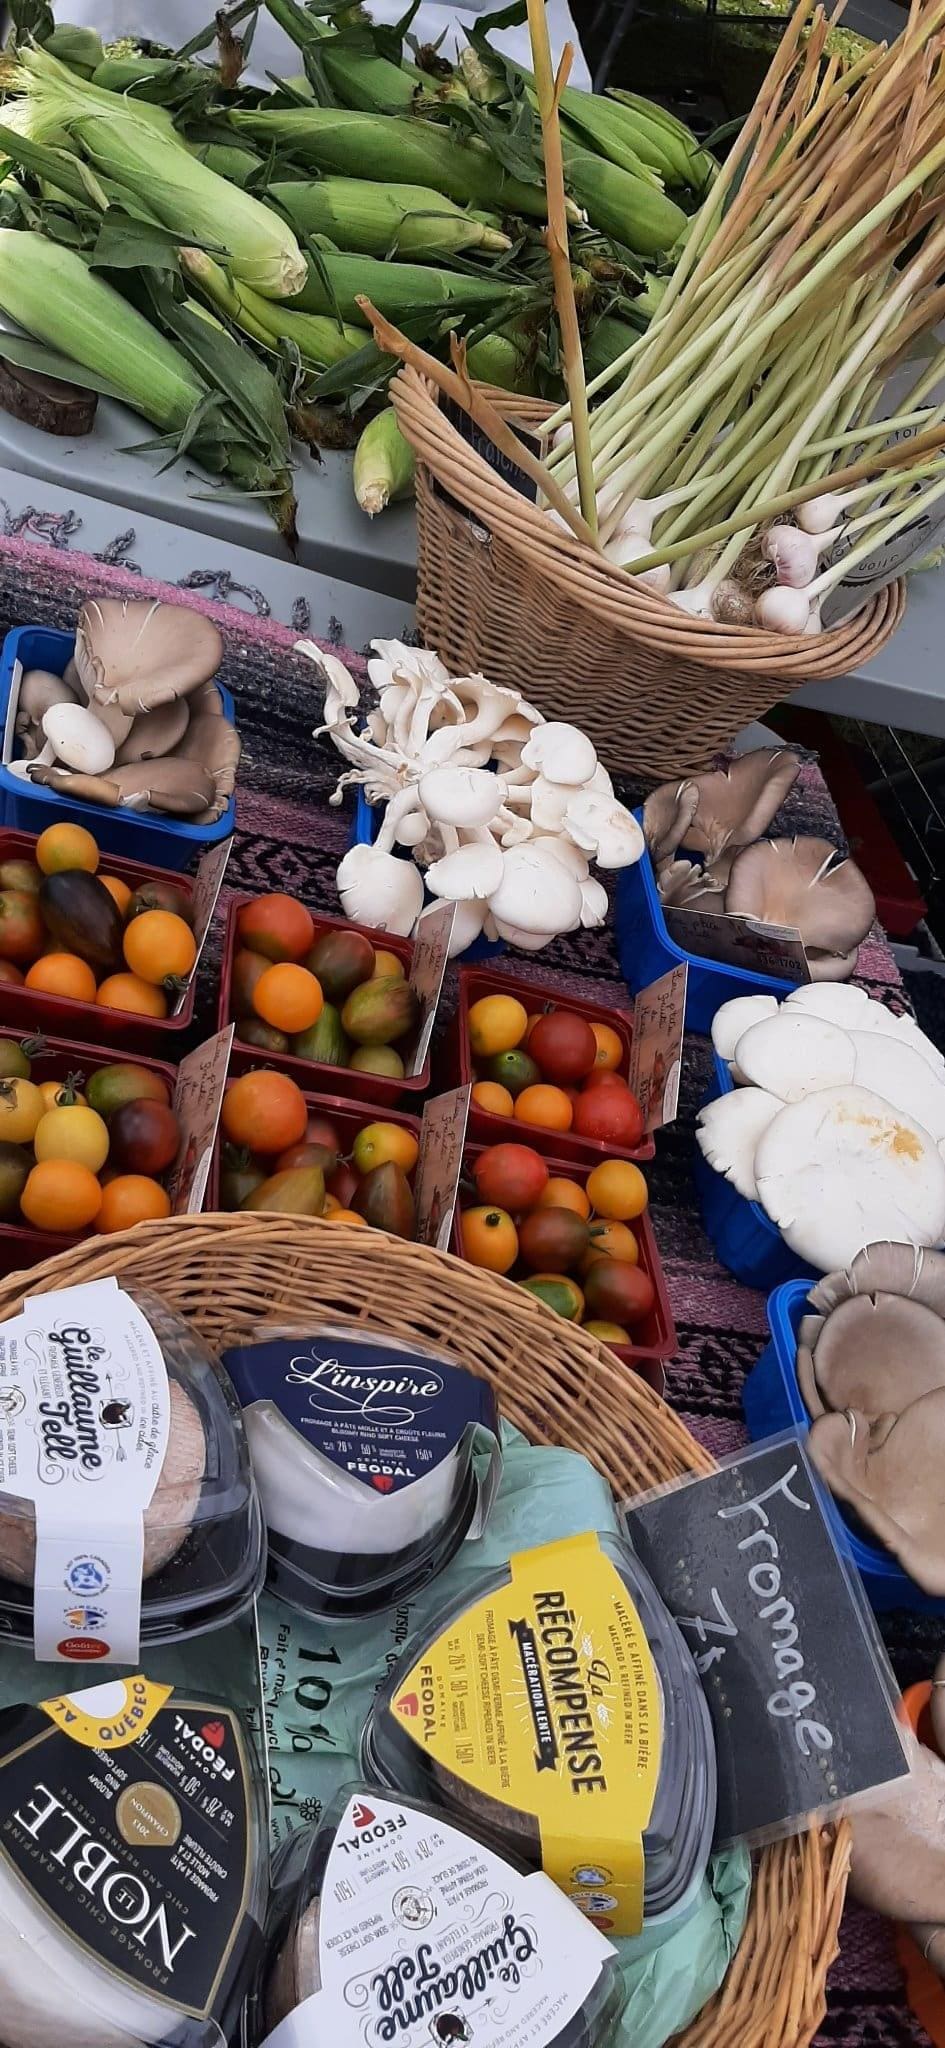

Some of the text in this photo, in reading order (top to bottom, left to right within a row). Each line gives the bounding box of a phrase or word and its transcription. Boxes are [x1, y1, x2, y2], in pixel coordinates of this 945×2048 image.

[86, 1345, 105, 1361] le
[49, 1326, 101, 1473] Guillaume
[150, 1402, 161, 1425] cidre
[38, 1401, 79, 1461] Tell
[134, 1429, 145, 1451] cider
[149, 1426, 159, 1439] de
[142, 1440, 157, 1470] glace
[391, 1601, 415, 1647] lorsqu
[484, 1609, 496, 1644] FROMAGE
[612, 1600, 635, 1639] MACÉRÉ
[718, 1464, 834, 1757] Fromage
[274, 1623, 291, 1656] Fait
[475, 1633, 487, 1670] SEMI-SOFT
[608, 1624, 624, 1662] MACERED
[488, 1652, 500, 1669] PÂTE
[629, 1651, 644, 1686] AFFINÉ
[478, 1672, 489, 1699] CHEESE
[522, 1641, 551, 1743] MACÉRATION LENTE
[585, 1658, 612, 1697] La
[620, 1673, 631, 1707] REFINED
[435, 1675, 446, 1727] DOMAINE
[490, 1671, 503, 1718] DEMI-FERME
[636, 1690, 647, 1717] DANS
[98, 1681, 147, 1741] QUÉBEC
[481, 1701, 493, 1733] RIPENED
[624, 1711, 631, 1720] IN
[638, 1722, 647, 1734] LA
[90, 1742, 129, 1781] SOFT CHEESE
[172, 1736, 217, 1779] DOMAINE
[486, 1744, 496, 1765] BEER
[498, 1754, 507, 1764] LA
[637, 1738, 647, 1769] BIÈRE
[86, 1772, 114, 1799] BLOOMY
[102, 1771, 121, 1790] RIND
[128, 1796, 170, 1837] CHAMPION
[57, 1786, 191, 1914] CHIC AND REFINED CHEESE
[180, 1849, 193, 1861] ET
[181, 1833, 230, 1879] CROÛTE FLEURIE
[356, 1833, 402, 1860] DOMAINE
[9, 1784, 200, 1969] NOBLE
[167, 1853, 187, 1873] PÂTE
[189, 1856, 212, 1878] MOLLE
[0, 1817, 170, 1984] FROMAGE CHIC ET RAFFINÉ
[112, 1887, 137, 1911] LE
[187, 1870, 220, 1902] FROMAGE
[462, 1879, 489, 1896] FROMAGE
[469, 1919, 500, 1944] FROMAGE
[371, 1943, 442, 2012] Tell
[376, 1914, 538, 2041] Guillaume
[499, 1962, 521, 1985] le
[504, 2023, 520, 2037] AND
[529, 2023, 541, 2035] ET
